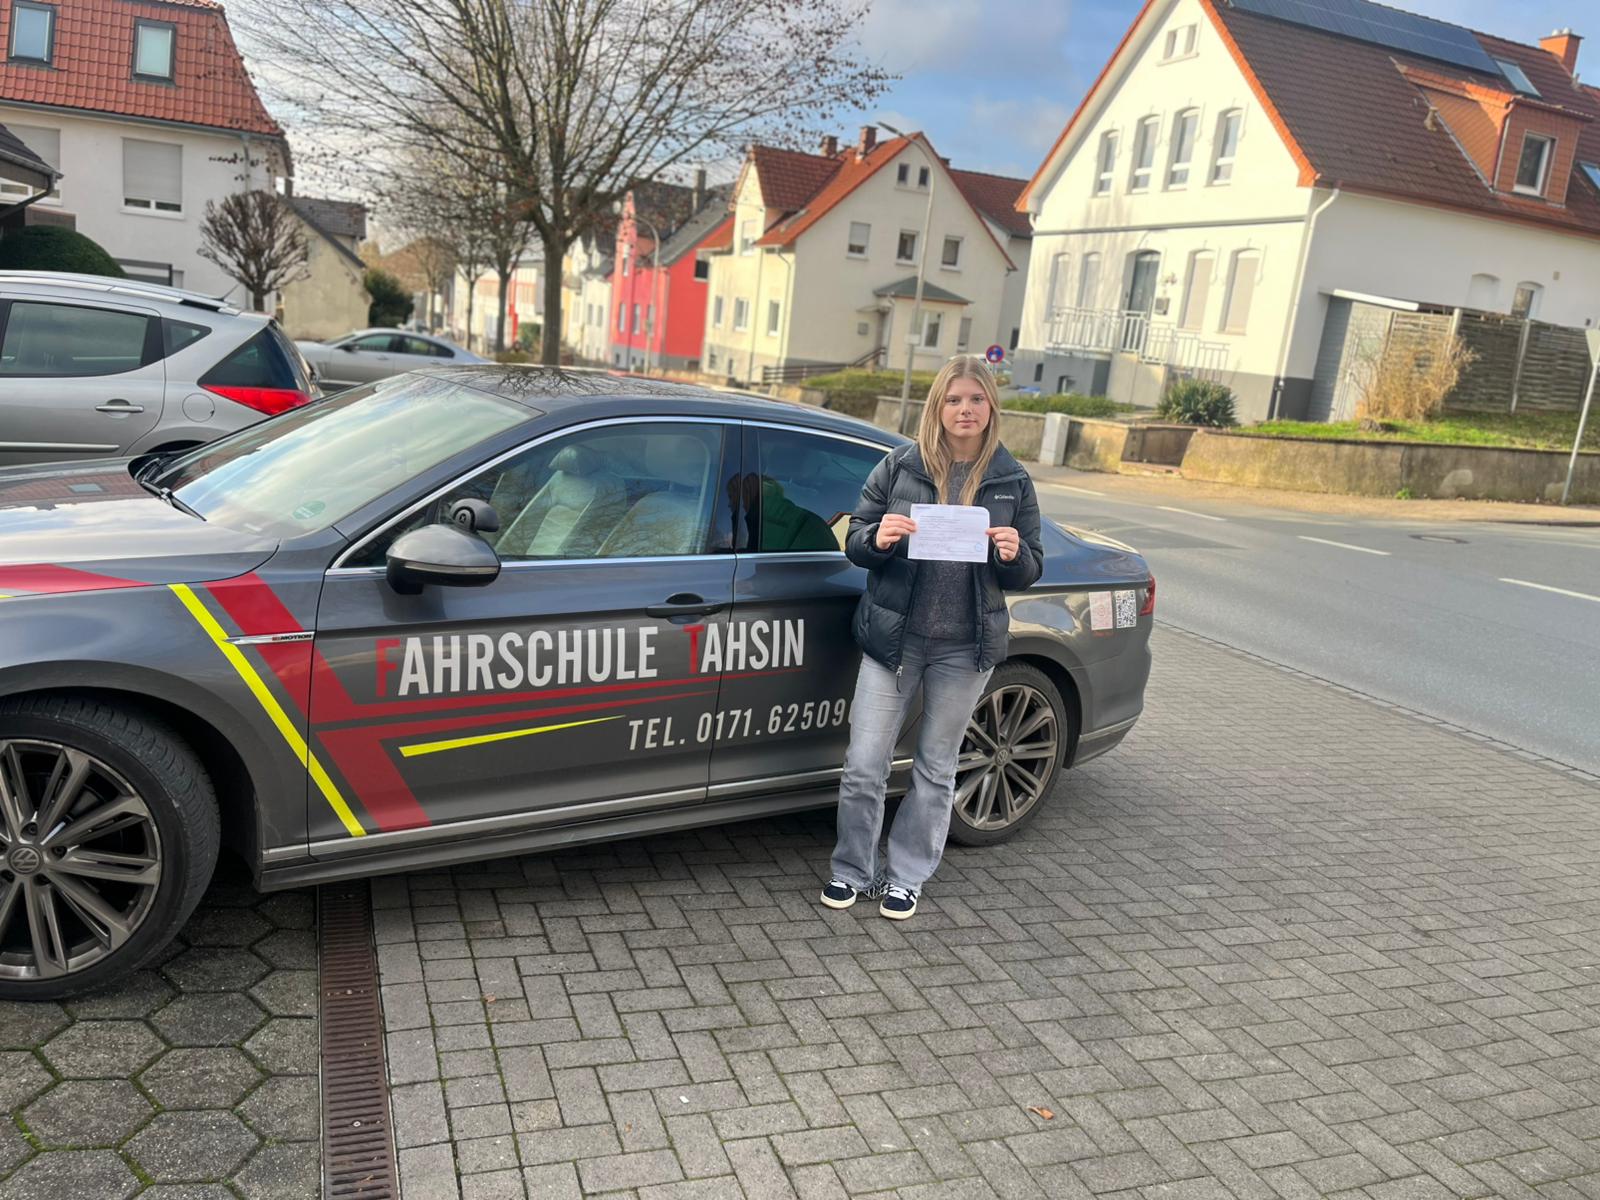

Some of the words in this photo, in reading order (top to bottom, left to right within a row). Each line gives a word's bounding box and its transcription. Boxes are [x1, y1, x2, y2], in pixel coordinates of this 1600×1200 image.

[375, 626, 658, 697] FAHRSCHULE
[683, 618, 805, 674] TAHSIN
[629, 717, 686, 751] TEL.
[696, 698, 853, 743] 0171.62509
